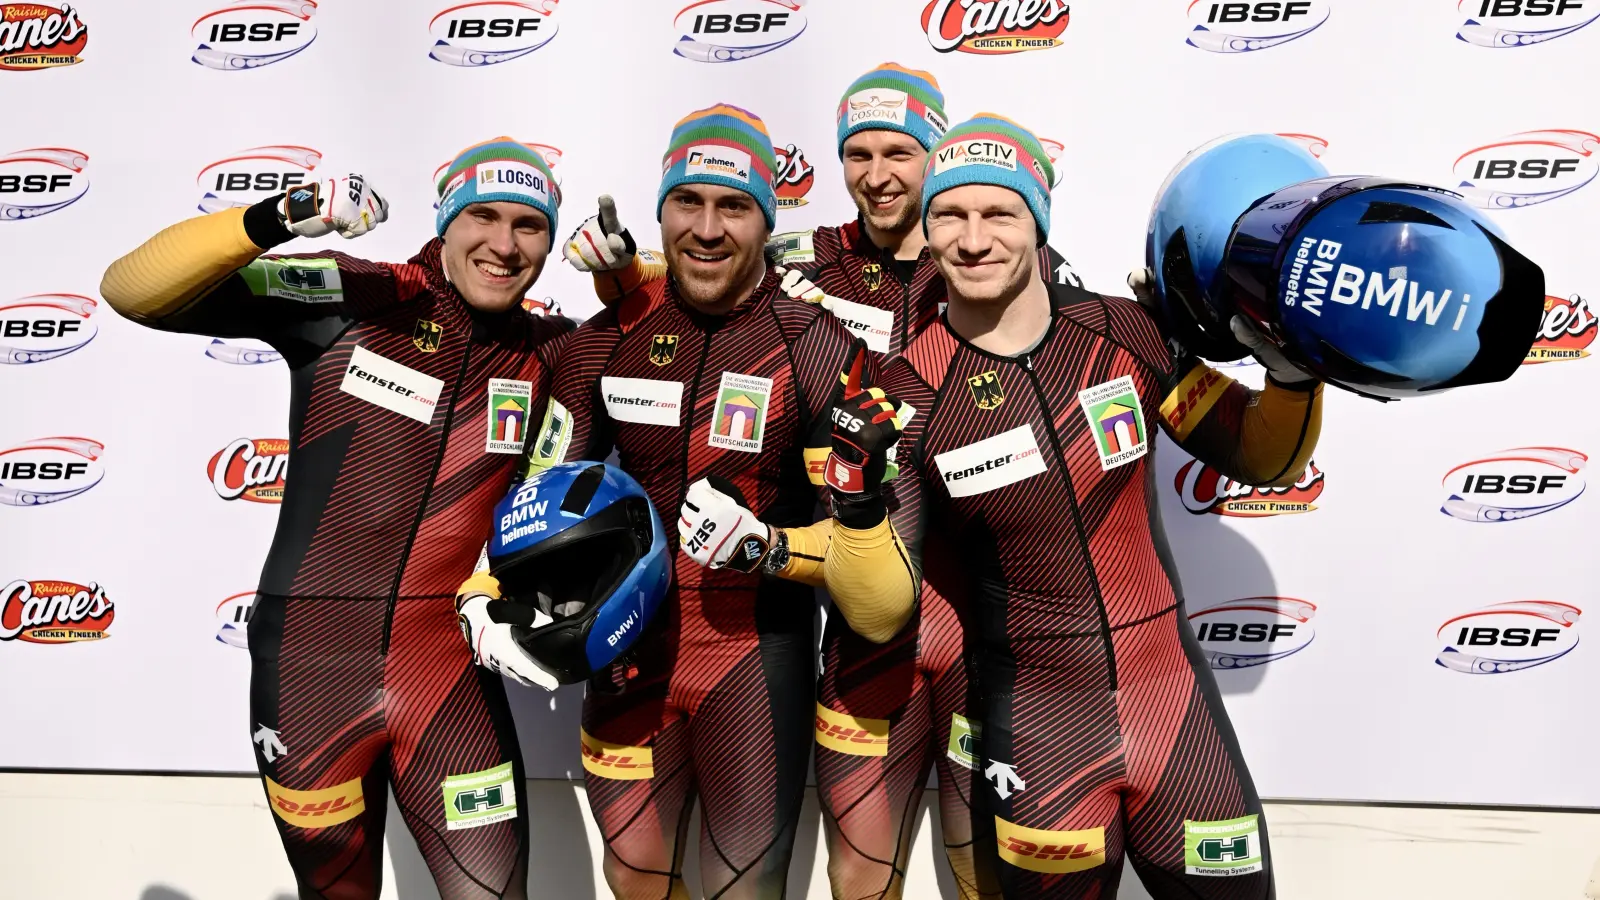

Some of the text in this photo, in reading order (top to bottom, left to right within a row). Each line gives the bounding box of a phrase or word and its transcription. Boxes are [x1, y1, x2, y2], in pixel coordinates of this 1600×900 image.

[5, 6, 48, 19] Raising
[1207, 1, 1311, 23] IBSF
[1478, 0, 1583, 17] IBSF
[0, 3, 87, 52] ane's
[209, 22, 300, 42] IBSF
[447, 18, 541, 38] IBSF
[692, 12, 789, 34] IBSF
[974, 39, 1054, 48] CHICKEN FINGERS
[4, 56, 75, 64] CHICKEN FINGERS
[851, 109, 898, 122] COSONA
[703, 156, 735, 168] rahmen
[939, 142, 1013, 163] VIACTIV
[964, 156, 1014, 169] Krankenkasse
[706, 163, 748, 179] versand.de
[1473, 158, 1580, 180] IBSF
[0, 174, 72, 193] BSF
[215, 172, 305, 192] IBSF
[498, 169, 546, 195] LOGSOL
[1285, 236, 1317, 307] helmets
[1301, 239, 1342, 317] BMW
[1330, 263, 1452, 326] BMW
[348, 365, 435, 407] fenster.com
[608, 394, 677, 409] fenster.com
[489, 442, 523, 450] DEUTSCHLAND
[712, 436, 759, 449] DEUTSCHLAND
[943, 447, 1038, 482] fenster.com
[1105, 444, 1146, 466] DEUTSCHLAND
[1, 462, 89, 480] IBSF
[1462, 474, 1567, 494] IBSF
[501, 500, 548, 532] BMW
[1227, 502, 1308, 511] CHICKEN FINGERS
[501, 520, 548, 546] helmets
[687, 518, 717, 555] SEIZ
[35, 583, 77, 596] Raising
[0, 579, 114, 639] Cane's
[32, 630, 102, 639] CHICKEN FINGERS
[607, 614, 634, 647] BMW
[1197, 622, 1297, 642] IBSF
[1456, 627, 1562, 648] IBSF
[276, 795, 353, 817] DHL
[1006, 836, 1094, 861] DHL
[1195, 865, 1255, 875] Tunnelling Systems
